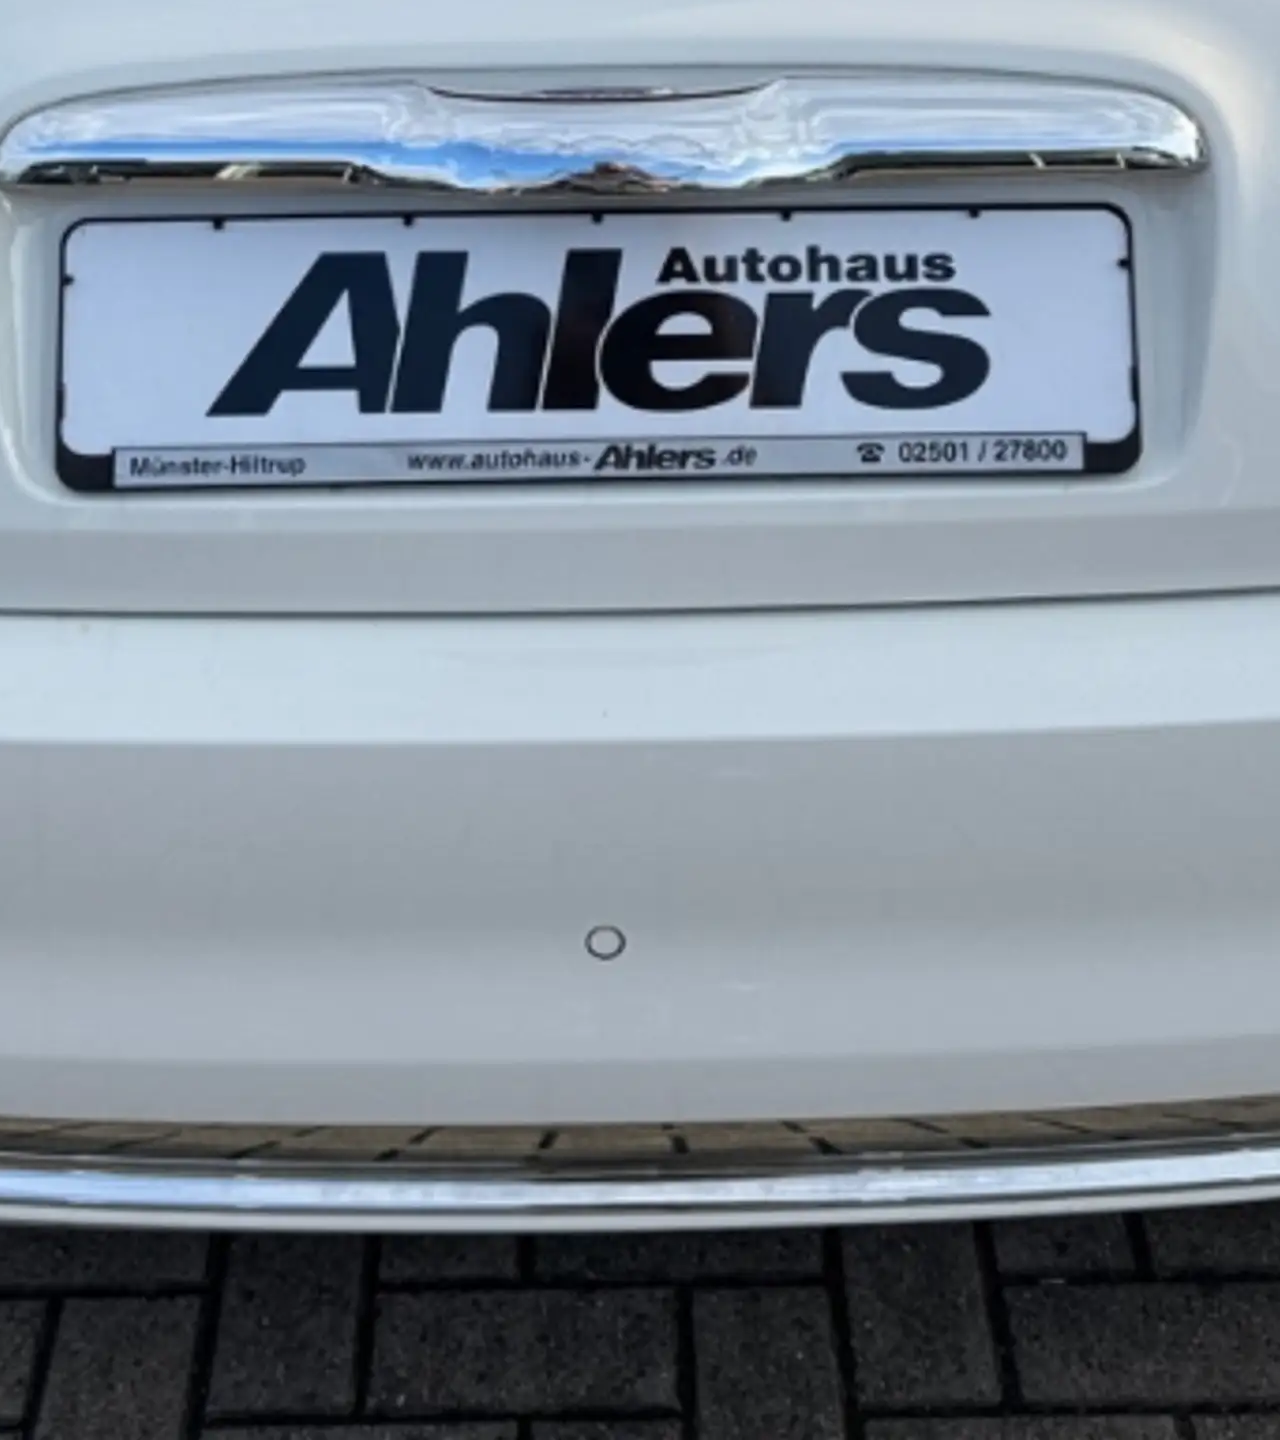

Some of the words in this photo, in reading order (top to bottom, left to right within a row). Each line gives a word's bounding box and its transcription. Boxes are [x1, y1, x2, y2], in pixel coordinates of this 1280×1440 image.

[656, 245, 957, 284] Autohaus
[206, 247, 991, 417] Ahlers
[129, 454, 306, 478] Münster-Hiltrup
[898, 441, 970, 464] 02501
[992, 439, 1067, 462] 27800
